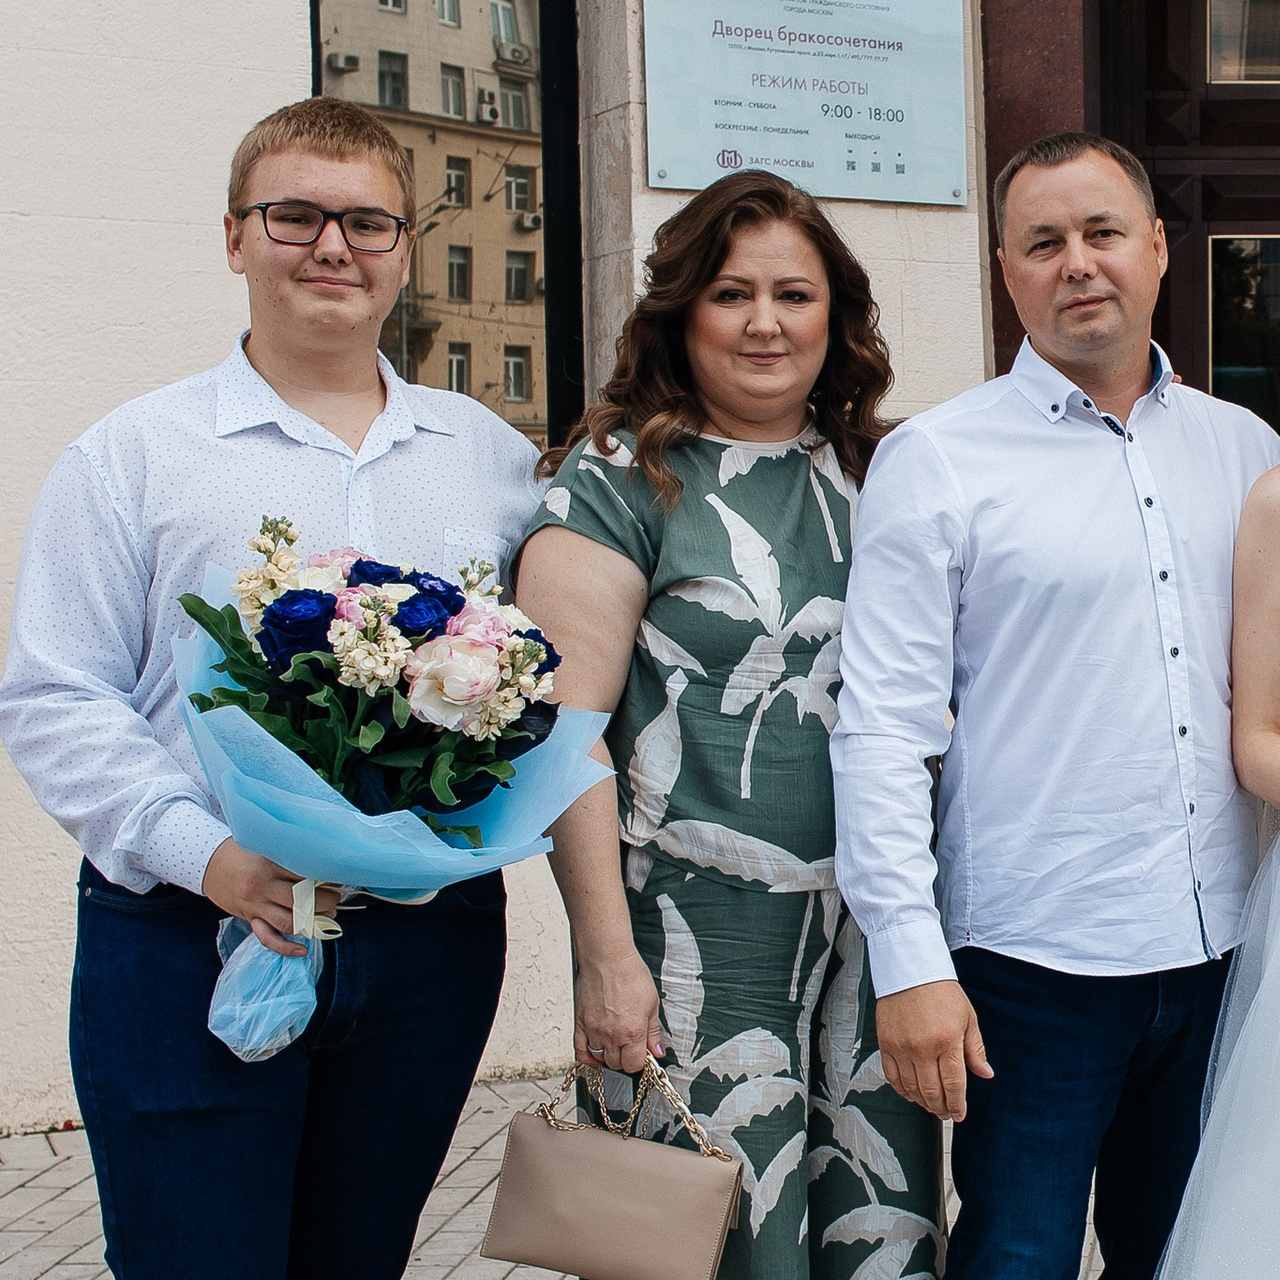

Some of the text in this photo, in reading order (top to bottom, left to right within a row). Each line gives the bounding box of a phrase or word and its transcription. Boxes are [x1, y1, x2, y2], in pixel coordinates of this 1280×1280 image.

[712, 20, 904, 52] Дворец бракосочетания
[751, 73, 869, 96] РЕЖИМ РАБОТЫ
[714, 99, 743, 108] ВТОРНИК
[748, 101, 777, 110] СУББОТА
[820, 103, 853, 119] 9:00
[868, 107, 905, 123] 18:00
[714, 123, 758, 132] ВОСКРЕСЕНЬЕ
[763, 126, 810, 135] ПОНЕДЕЛЬНИК
[844, 132, 881, 141] ВЫХОДНОЙ
[748, 156, 815, 169] ЗАГС МОСКВЫ
